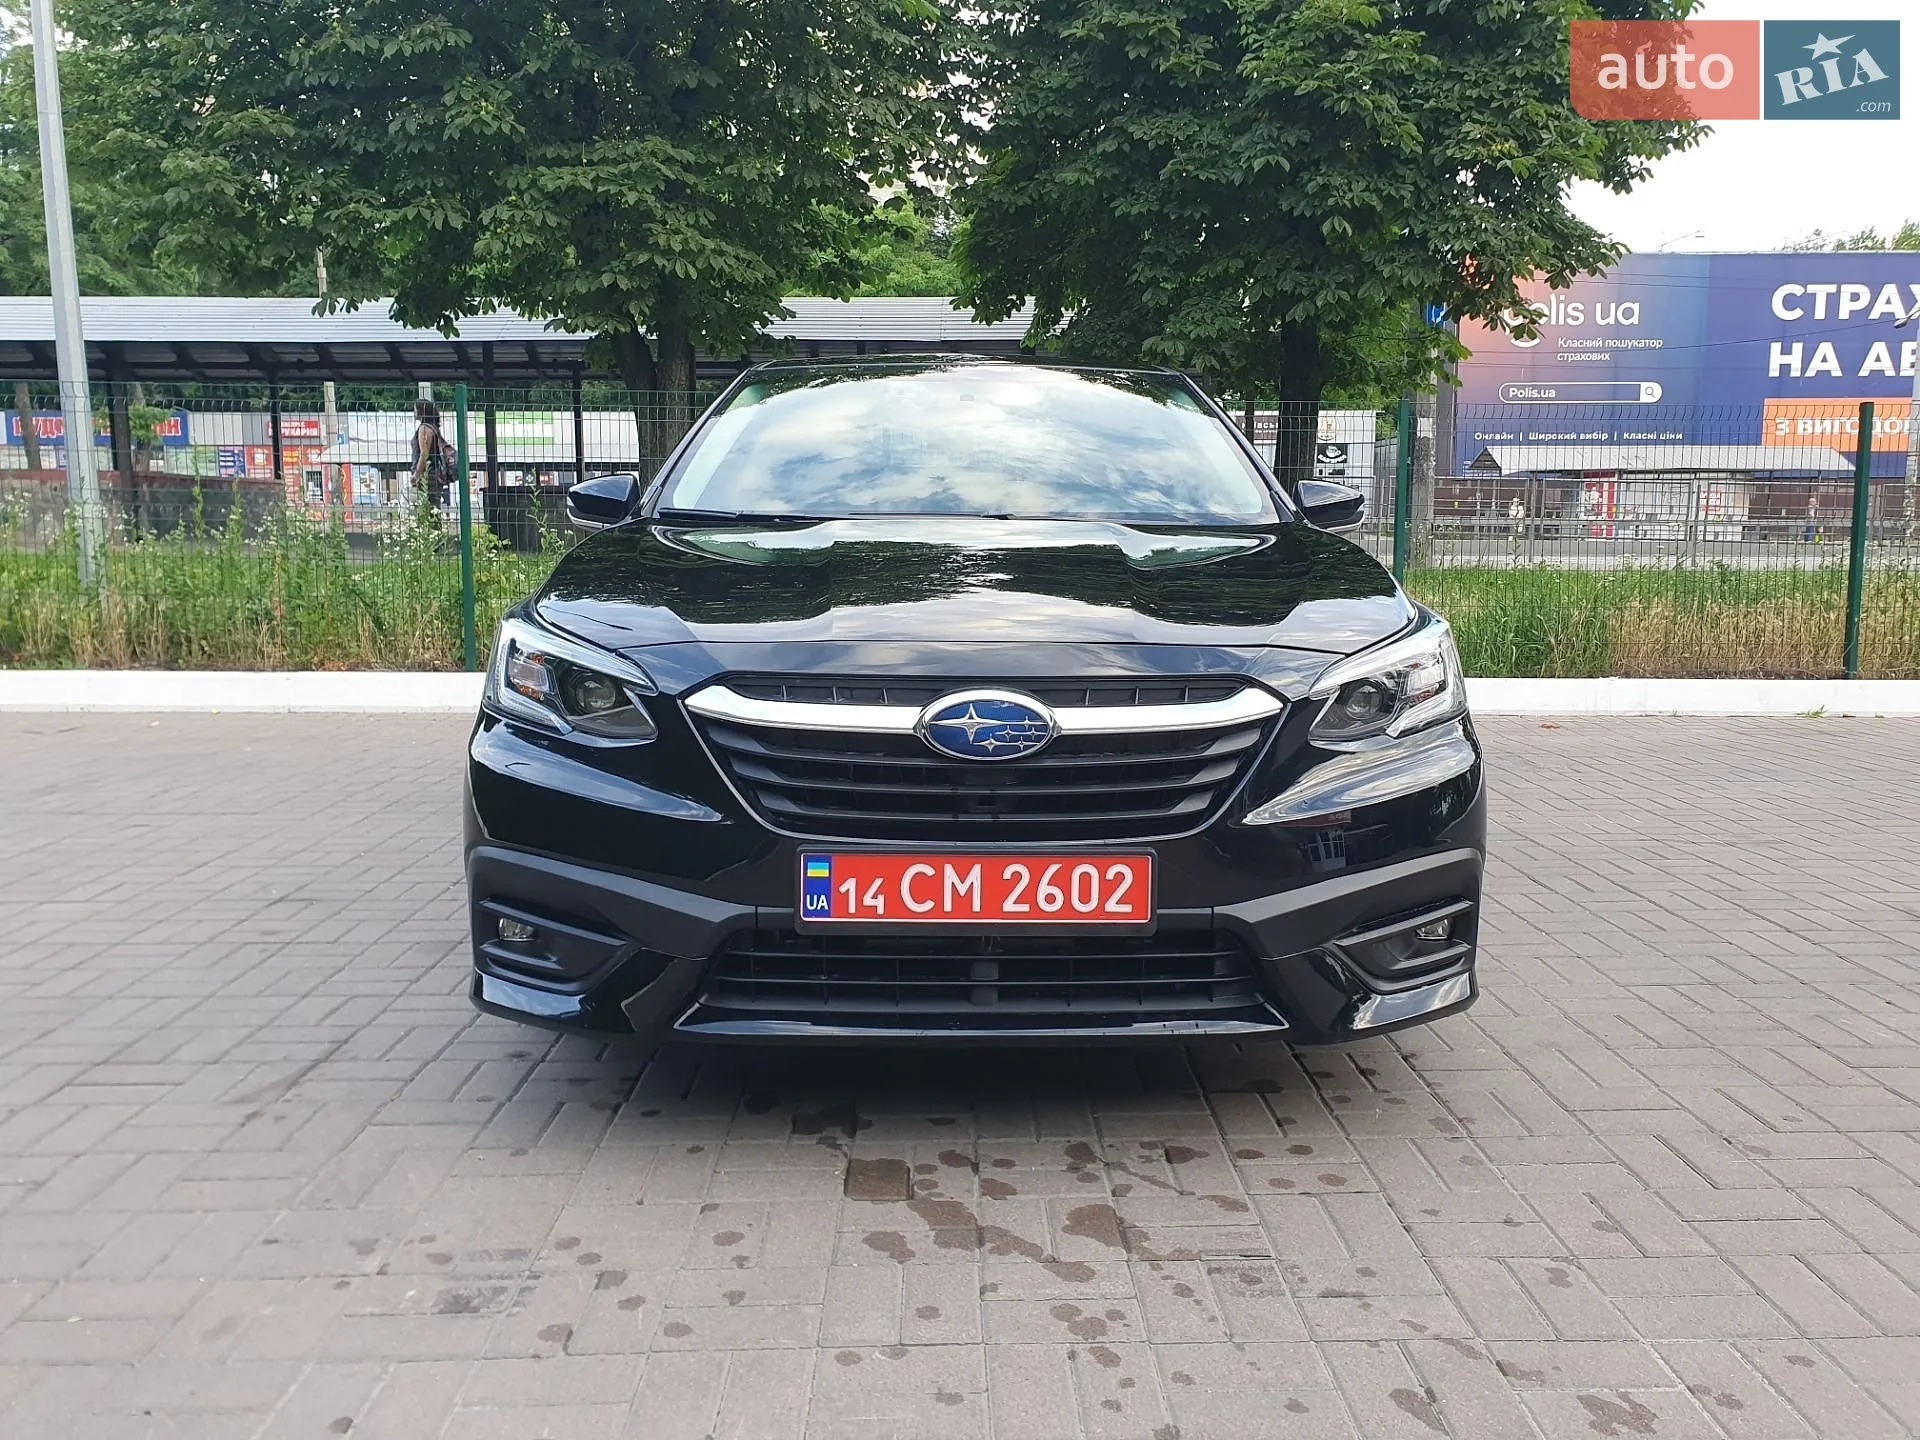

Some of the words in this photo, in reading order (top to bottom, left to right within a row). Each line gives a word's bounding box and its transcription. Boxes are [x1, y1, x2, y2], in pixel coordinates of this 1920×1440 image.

[1595, 302, 1640, 325] ua
[1557, 337, 1602, 348] Класний
[1605, 339, 1663, 349] пошукатор
[1557, 351, 1611, 362] страхових
[1768, 341, 1843, 377] НА
[1509, 386, 1556, 399] Polis.ua
[1474, 431, 1514, 441] Онлайн
[838, 877, 885, 915] 14
[900, 863, 982, 913] CM
[1002, 863, 1134, 914] 2602
[806, 893, 829, 911] UA
